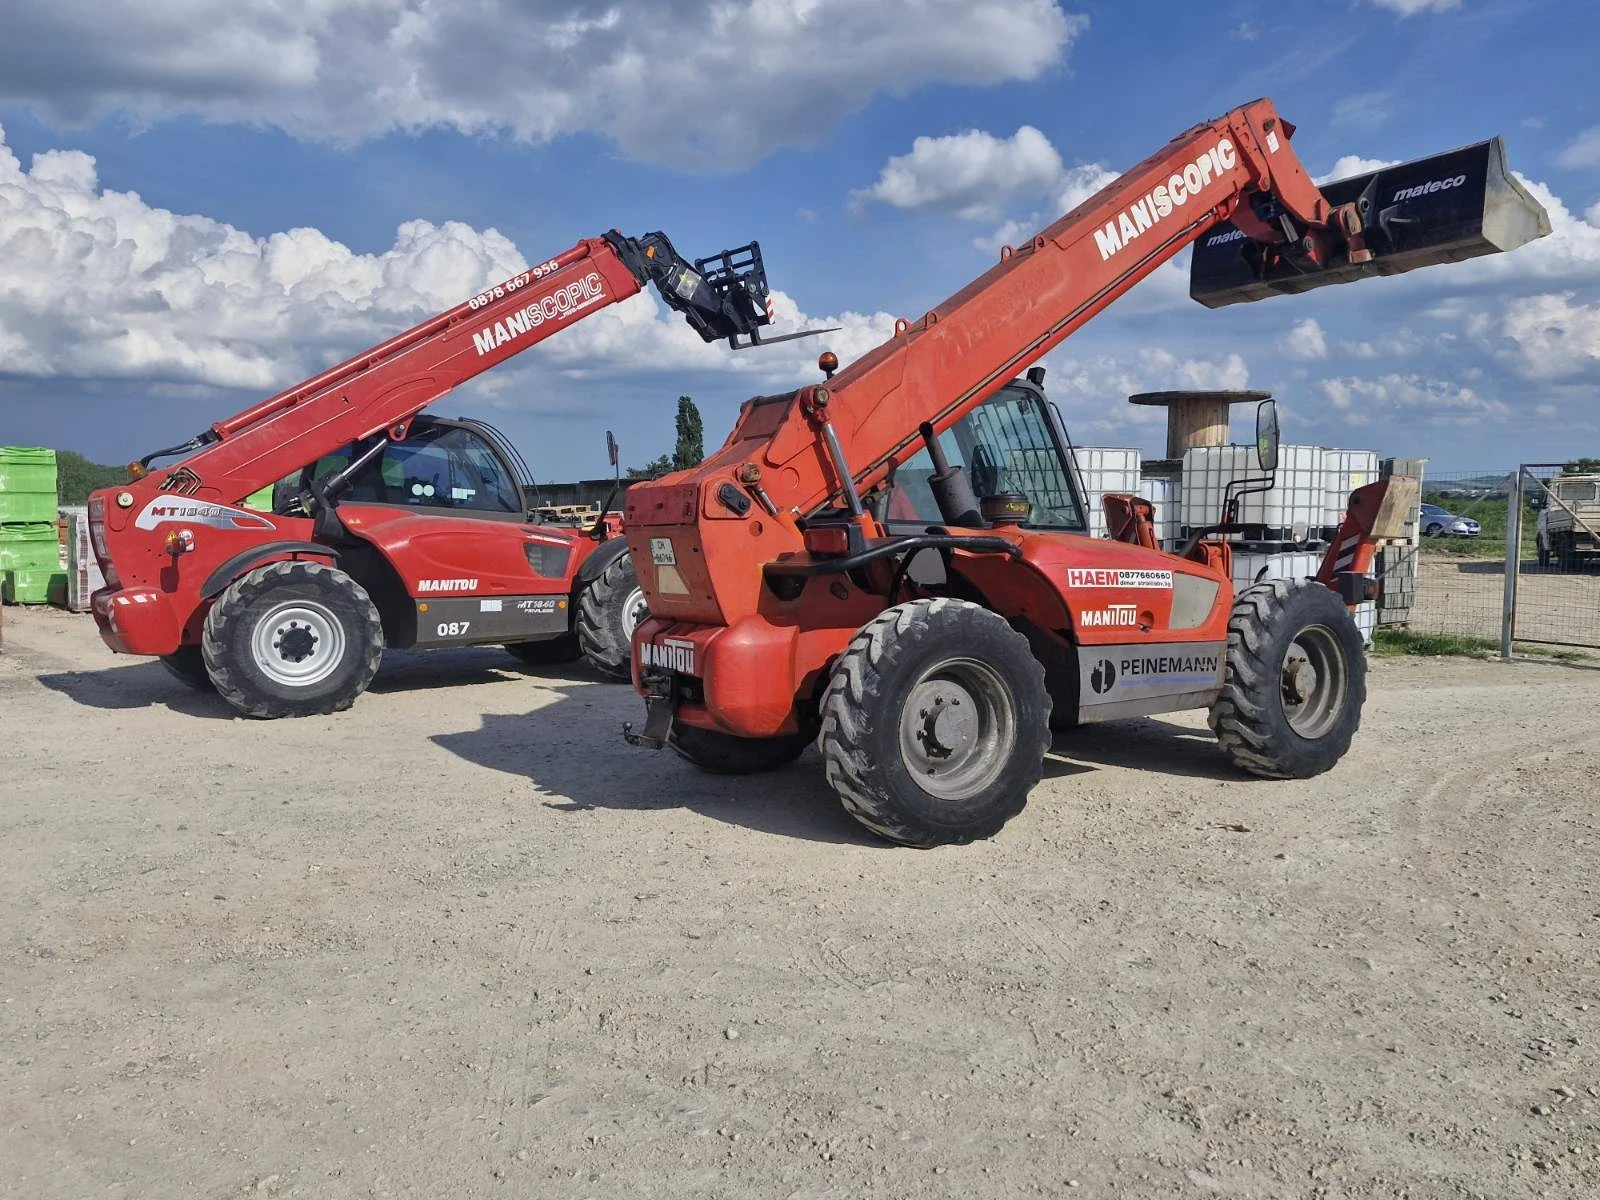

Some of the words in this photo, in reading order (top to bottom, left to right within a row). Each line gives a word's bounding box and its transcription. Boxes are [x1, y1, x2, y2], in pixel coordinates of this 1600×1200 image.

[1093, 138, 1236, 261] MANISCOPIC
[1392, 174, 1466, 202] mateco
[1206, 229, 1248, 247] mate
[468, 286, 505, 310] 0878
[506, 273, 531, 292] 667
[533, 259, 559, 279] 956
[472, 272, 602, 357] MANISCOPIC
[418, 578, 478, 592] MANITOU
[1081, 604, 1137, 626] MANITOU
[436, 621, 470, 637] 087
[640, 638, 694, 674] MANITOU
[1121, 657, 1218, 676] PEINEMANN
